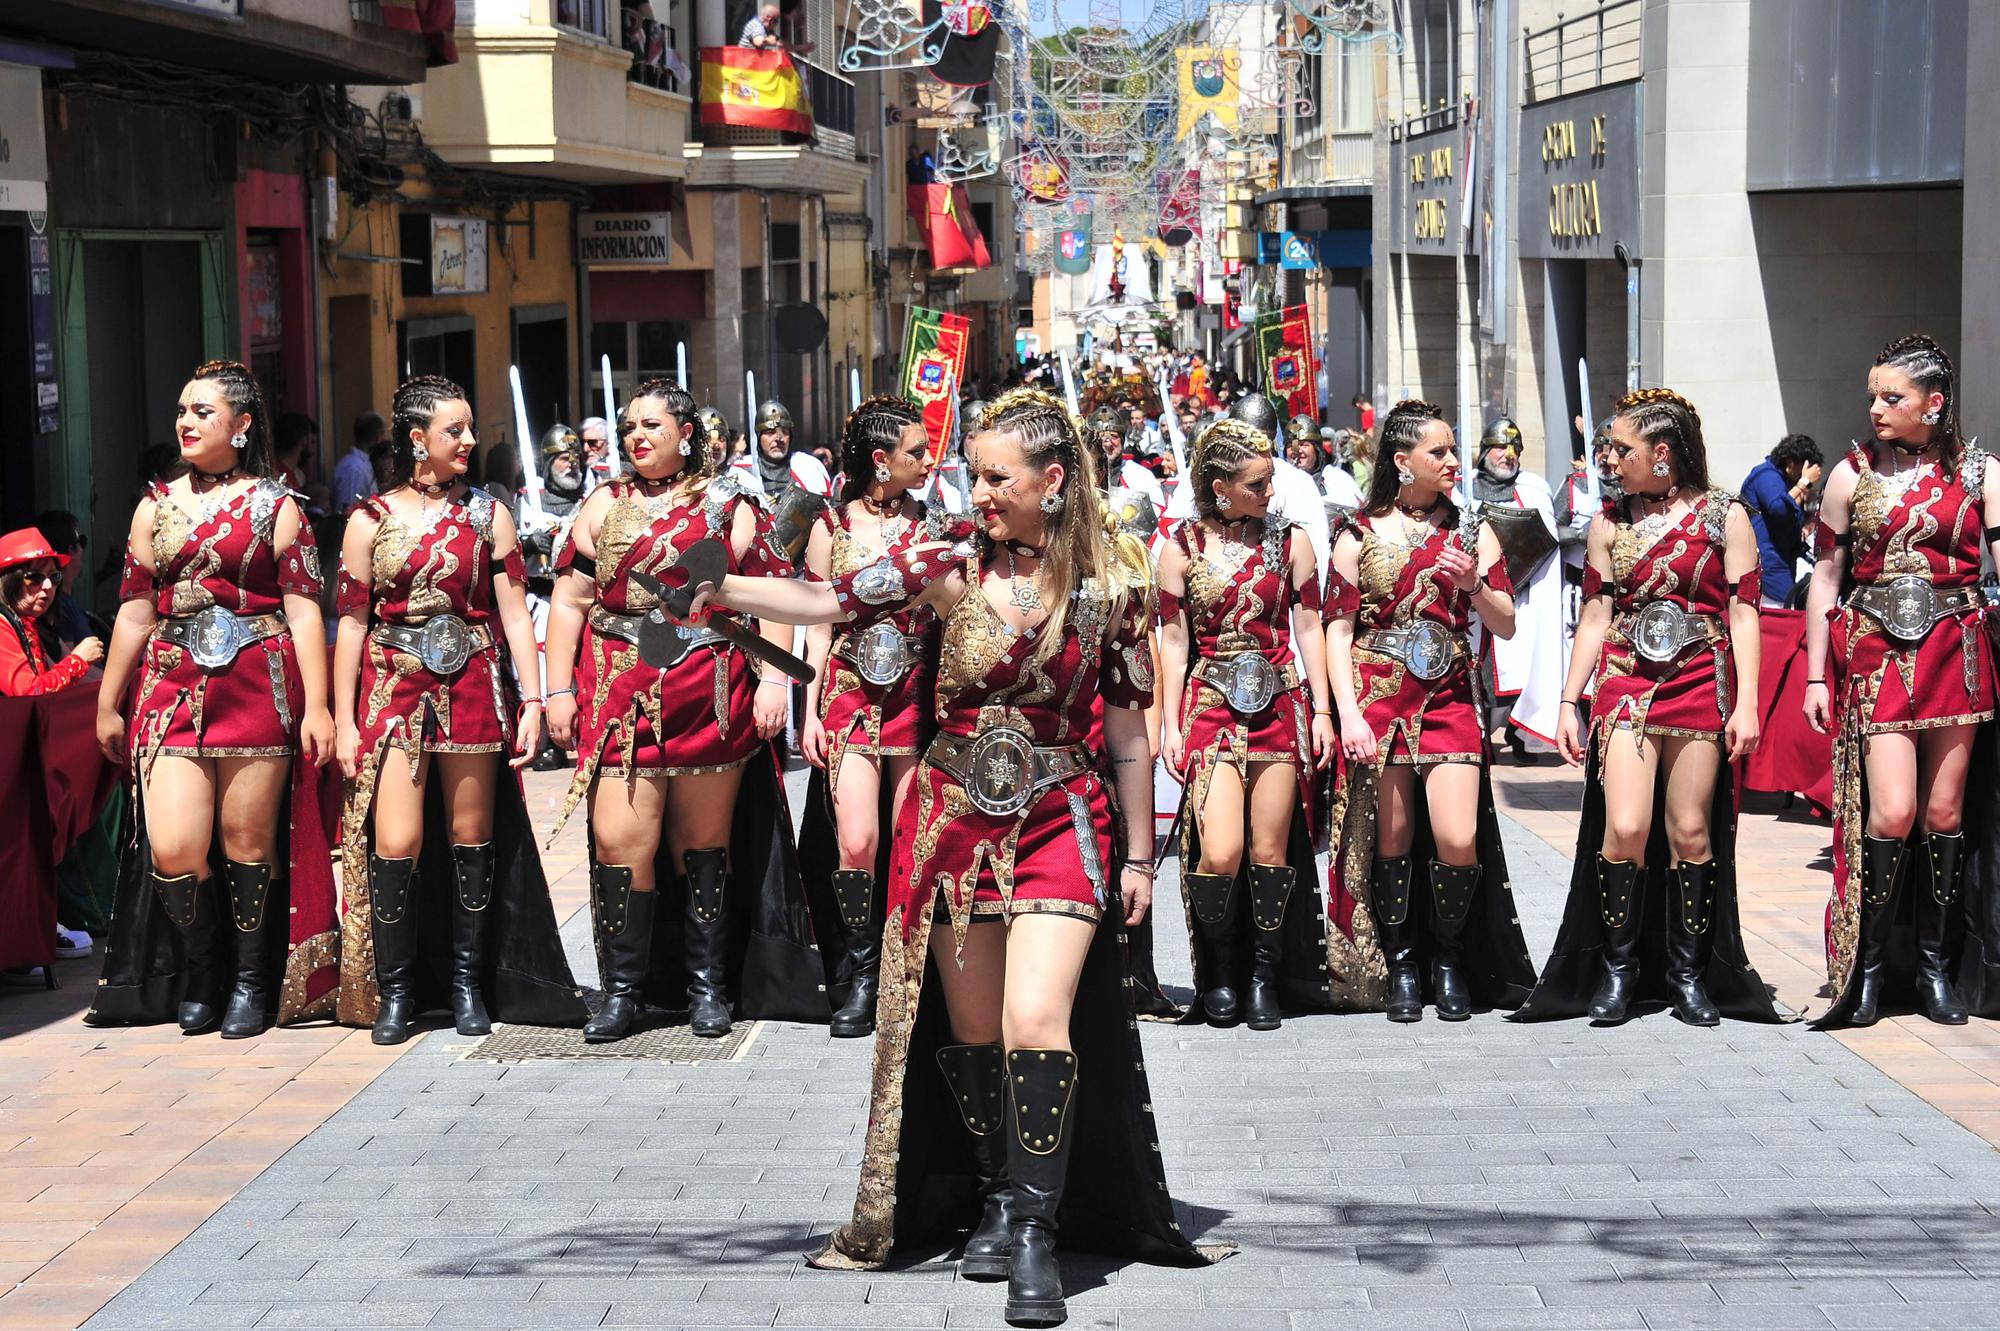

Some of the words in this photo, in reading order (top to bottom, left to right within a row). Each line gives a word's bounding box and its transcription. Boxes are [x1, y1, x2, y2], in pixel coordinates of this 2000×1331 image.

[1549, 178, 1601, 236] CULTURA
[594, 219, 651, 232] DIARIO
[580, 235, 666, 259] INFORMACION
